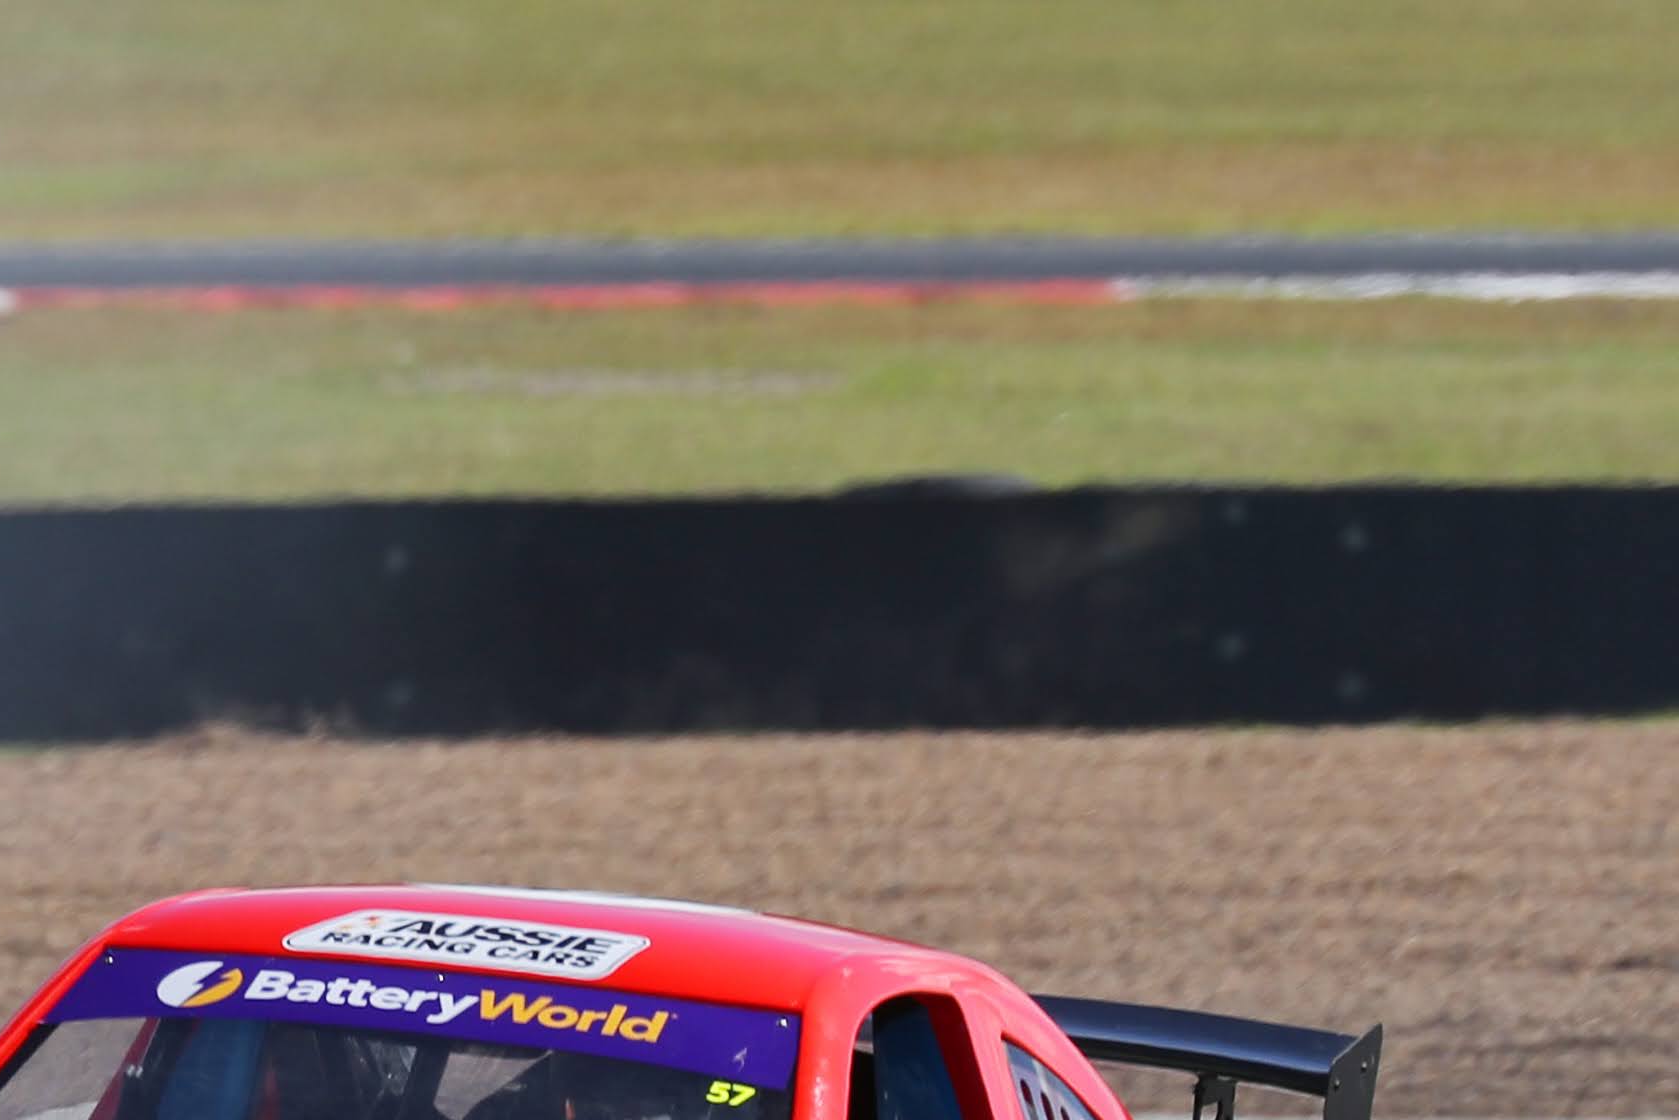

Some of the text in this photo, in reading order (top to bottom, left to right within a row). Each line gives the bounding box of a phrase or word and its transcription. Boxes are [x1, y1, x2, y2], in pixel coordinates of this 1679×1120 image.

[319, 930, 601, 970] RACING CARS
[386, 917, 621, 956] AUSSIE
[705, 1080, 757, 1107] 57
